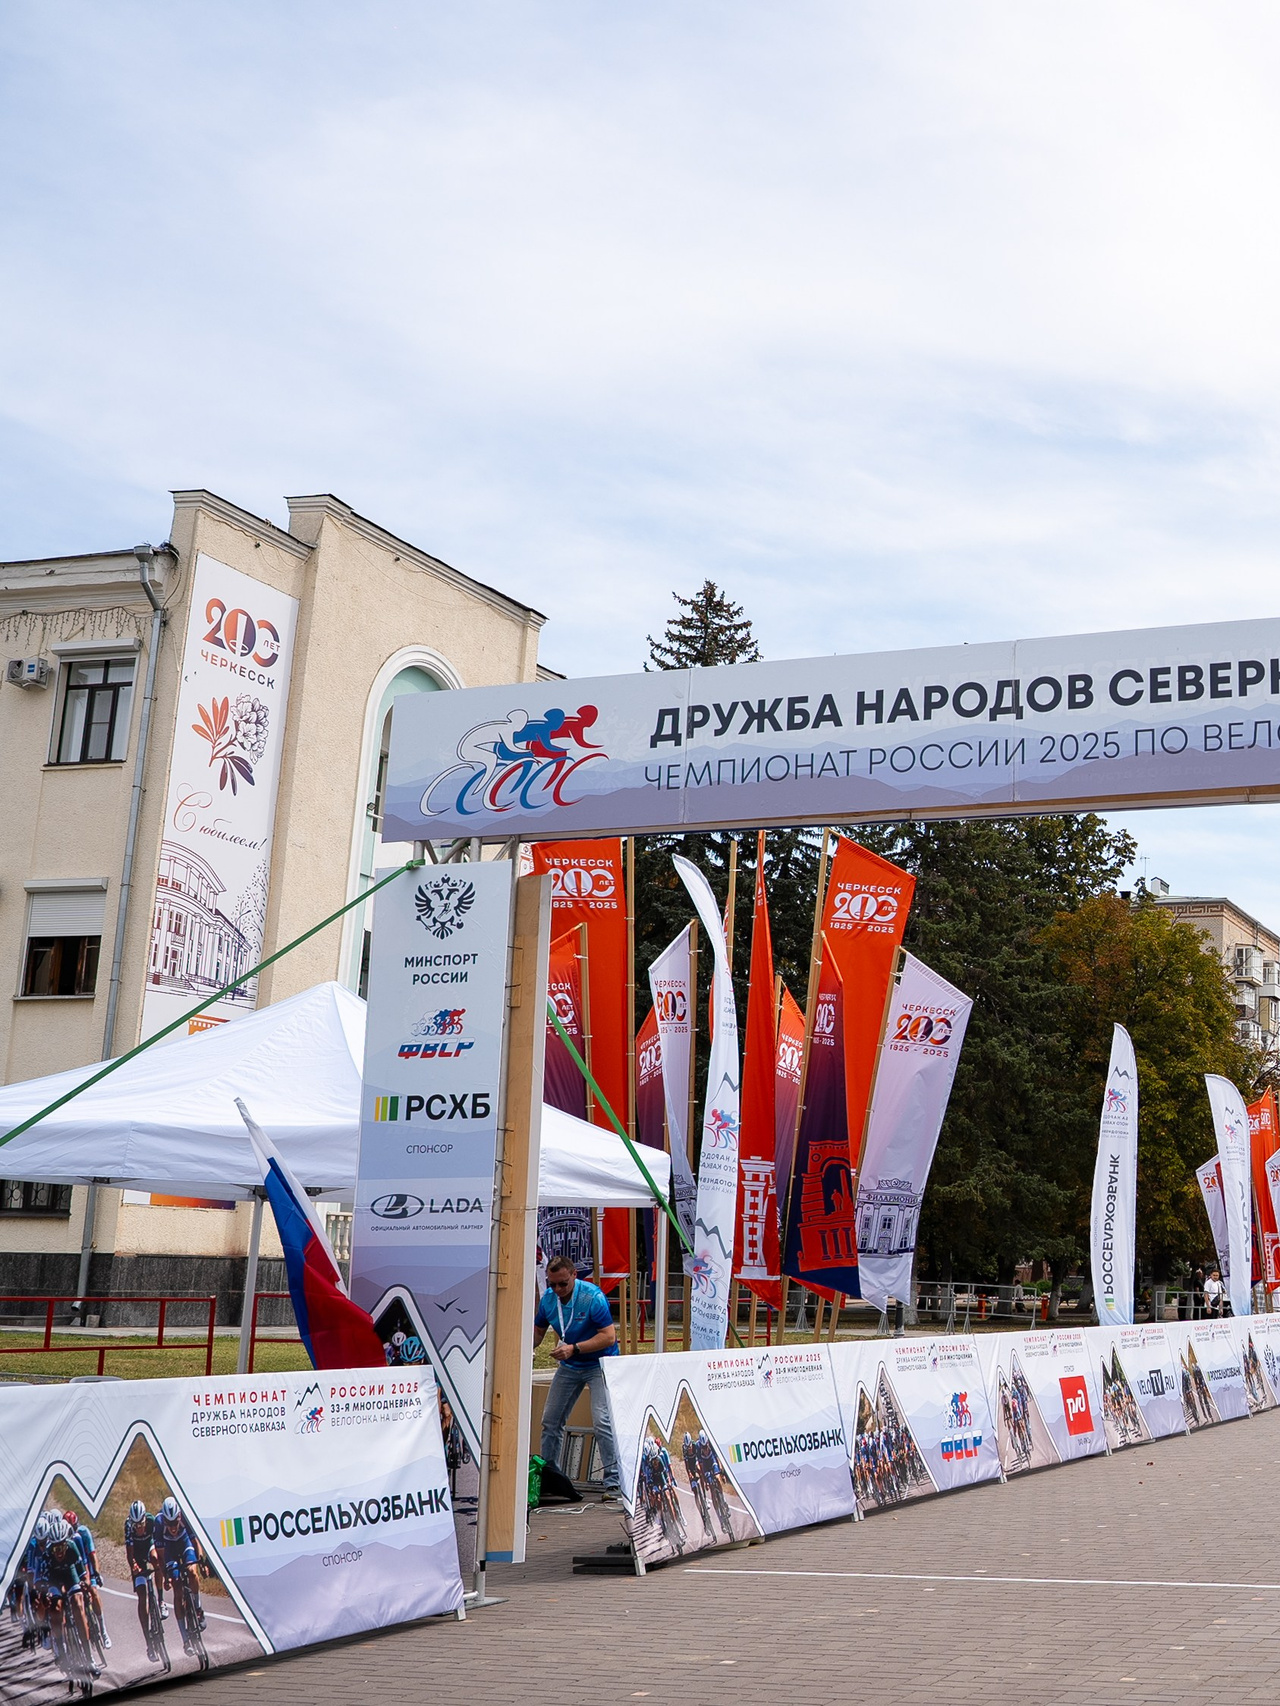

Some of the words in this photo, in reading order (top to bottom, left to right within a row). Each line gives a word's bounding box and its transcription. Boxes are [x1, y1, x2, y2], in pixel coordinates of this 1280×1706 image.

[203, 597, 280, 668] 200
[263, 639, 281, 652] ЛЕТ
[200, 649, 276, 689] ЧЕРКЕССК
[650, 693, 843, 749] ДРУЖБА
[857, 667, 1094, 726] НАРОДОВ
[644, 750, 858, 791] ЧЕМПИОНАТ
[869, 738, 1025, 775] РОССИИ
[1039, 732, 1120, 763] 2025
[1134, 726, 1189, 757] ПО
[199, 818, 268, 850] юбилеем!
[545, 858, 613, 868] ЧЕРКЕССК
[837, 882, 902, 895] ЧЕРКЕССК
[552, 901, 574, 909] 825
[589, 901, 618, 909] 2025
[832, 891, 898, 922] 200
[829, 922, 853, 930] 1825
[867, 925, 895, 934] 2025
[404, 953, 478, 969] МИНСПОРТ
[412, 971, 468, 985] РОССИИ
[901, 1003, 957, 1017] ЧЕРКЕССК
[892, 1013, 953, 1045] 200
[397, 1036, 475, 1060] ФВСР
[889, 1044, 910, 1052] 1825
[922, 1048, 949, 1058] 2025
[405, 1092, 491, 1121] РСХБ
[406, 1143, 453, 1155] СПОНСОР
[428, 1197, 484, 1214] LADA
[370, 1224, 411, 1232] ОФИЦИАЛЬНЫЙ
[412, 1223, 459, 1231] АВТОМОБИЛЬНЫЙ
[461, 1223, 484, 1231] ПАРТНЕР
[707, 1358, 754, 1370] ЧЕМПИОНАТ
[774, 1356, 803, 1364] РОССИИ
[805, 1353, 821, 1362] 2025
[787, 1364, 823, 1374] МНОГОДНЕВНАЯ
[707, 1372, 730, 1381] ДРУЖБА
[731, 1370, 755, 1379] НАРОДОВ
[193, 1389, 287, 1407] ЧЕМПИОНАТ
[330, 1384, 386, 1399] РОССИИ
[391, 1382, 419, 1394] 2025
[330, 1403, 350, 1413] 33-Я
[352, 1398, 422, 1411] МНОГОДНЕВНАЯ
[191, 1408, 236, 1424] ДРУЖБА
[239, 1407, 287, 1420] НАРОДОВ
[331, 1415, 378, 1427] ВЕЛОГОНКА
[380, 1414, 391, 1422] НА
[392, 1409, 423, 1421] ШОССЕ
[192, 1424, 249, 1438] СЕВЕРНОГО
[249, 1421, 287, 1434] КАВКАЗА
[743, 1428, 845, 1462] РОССЕЛЬХОЗБАНК
[941, 1429, 983, 1462] ФВСР
[249, 1487, 450, 1544] РОССЕЛЬХОЗБАНК
[322, 1549, 364, 1568] СПОНСОР
